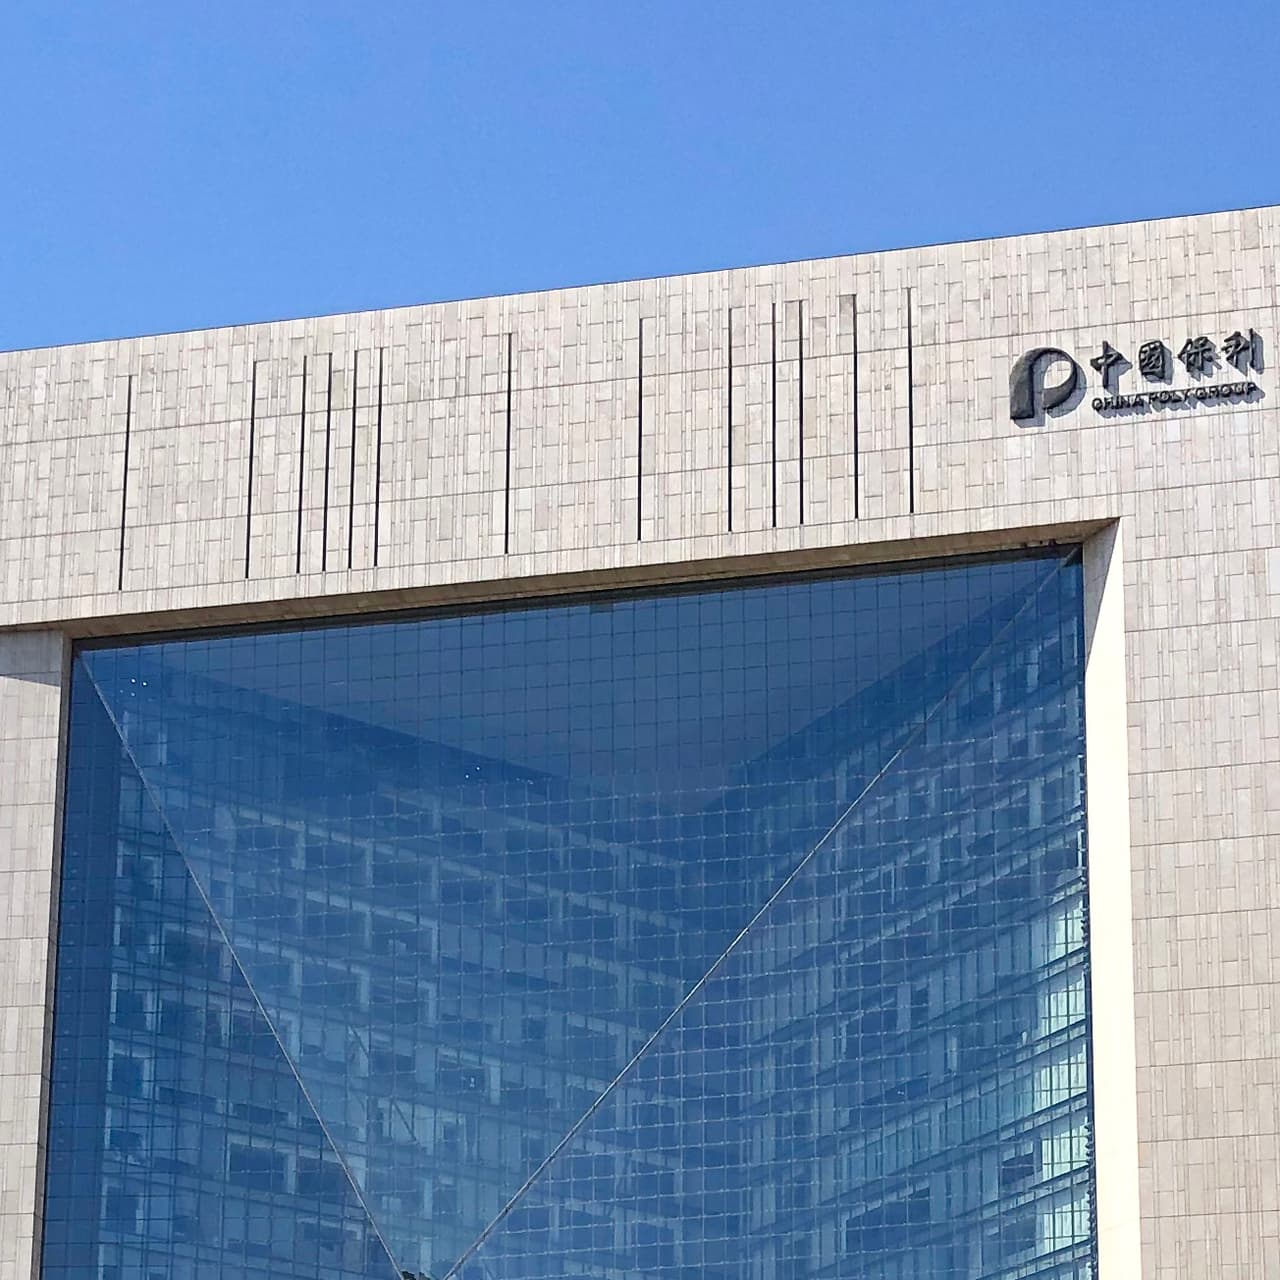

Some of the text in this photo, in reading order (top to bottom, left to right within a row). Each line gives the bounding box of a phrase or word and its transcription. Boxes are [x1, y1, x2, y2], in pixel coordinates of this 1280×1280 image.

[1091, 381, 1257, 412] CHINA POLY GROUP
